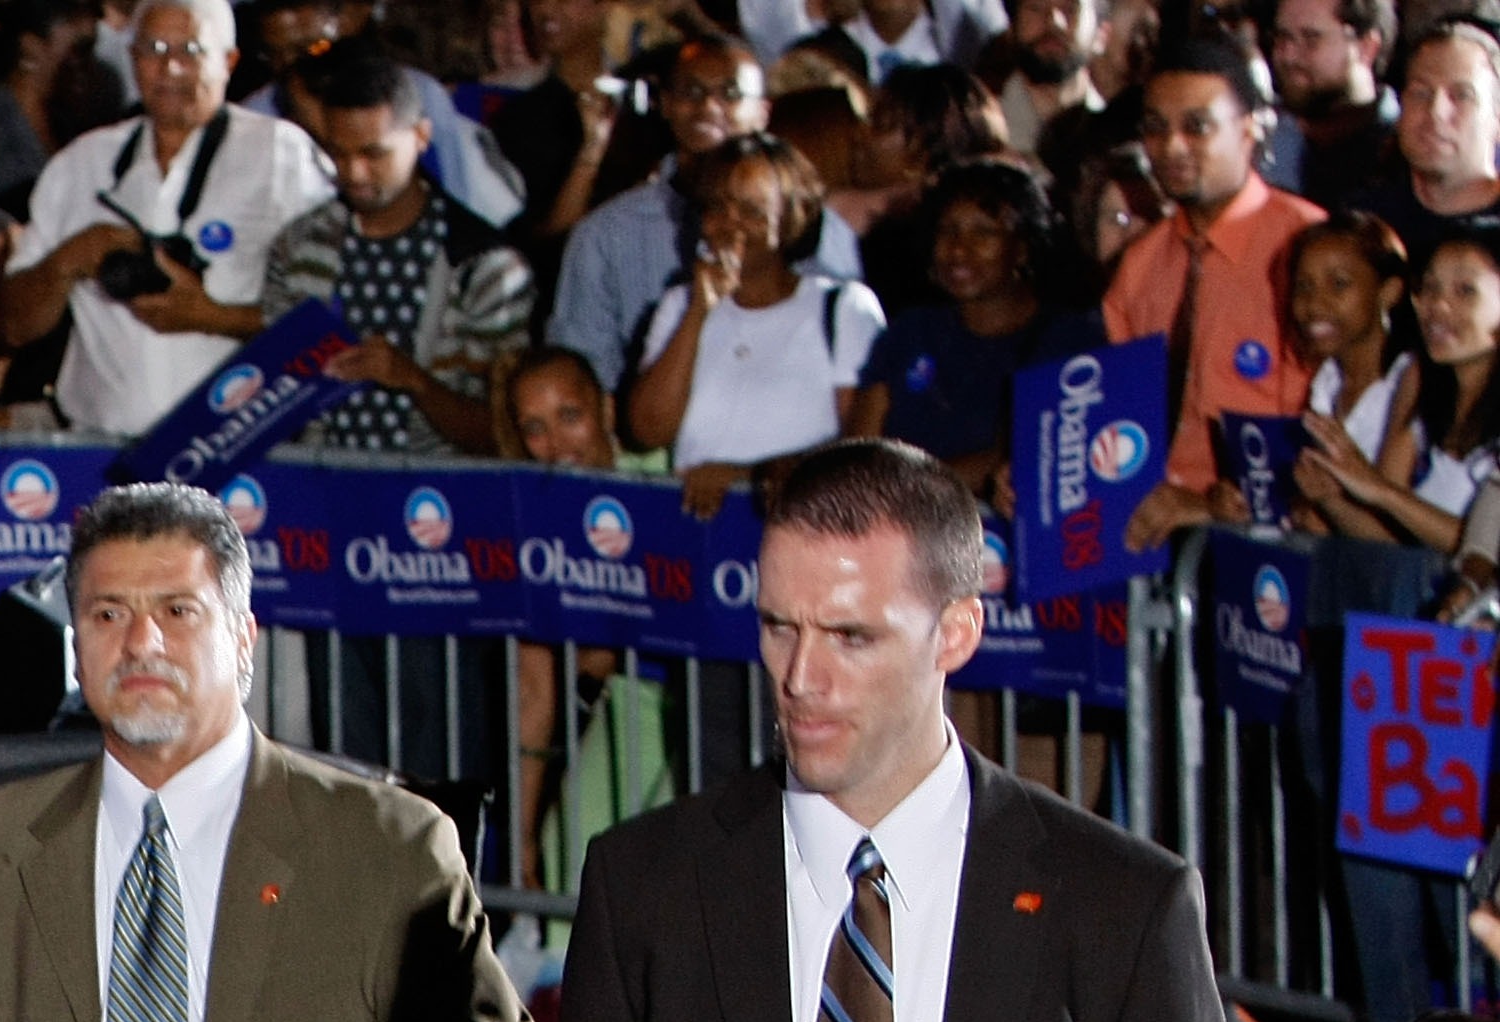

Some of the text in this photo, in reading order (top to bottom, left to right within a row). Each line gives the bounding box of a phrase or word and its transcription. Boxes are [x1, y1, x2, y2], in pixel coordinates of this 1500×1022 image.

[165, 374, 301, 484] Obama
[1058, 354, 1104, 513] Obama
[345, 535, 471, 584] Obama
[520, 537, 647, 597] Obama
